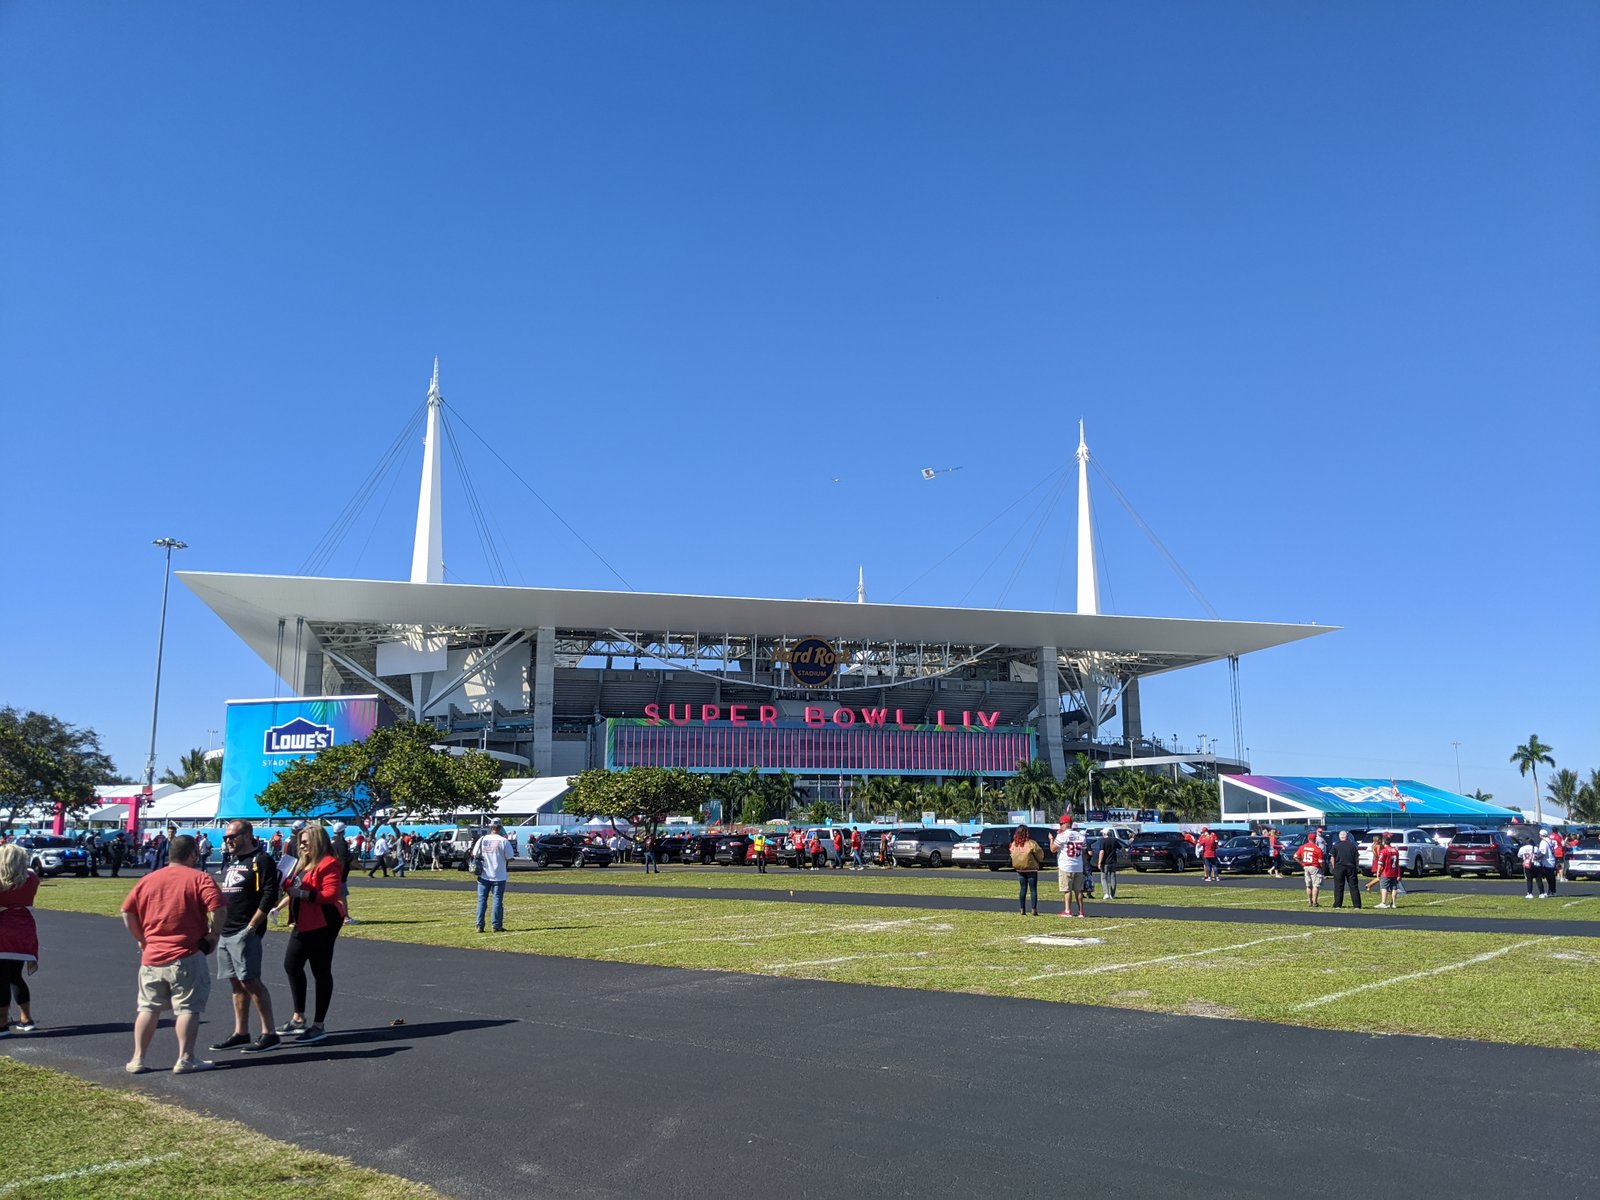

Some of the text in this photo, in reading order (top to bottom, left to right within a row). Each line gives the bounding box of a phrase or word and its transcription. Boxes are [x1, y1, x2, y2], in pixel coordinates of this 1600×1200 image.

[771, 645, 850, 668] Hard Rock
[644, 703, 1000, 731] SUPER BOWL LIV
[271, 731, 327, 750] LOWE'S
[1066, 841, 1083, 858] 85
[1303, 851, 1313, 862] 15
